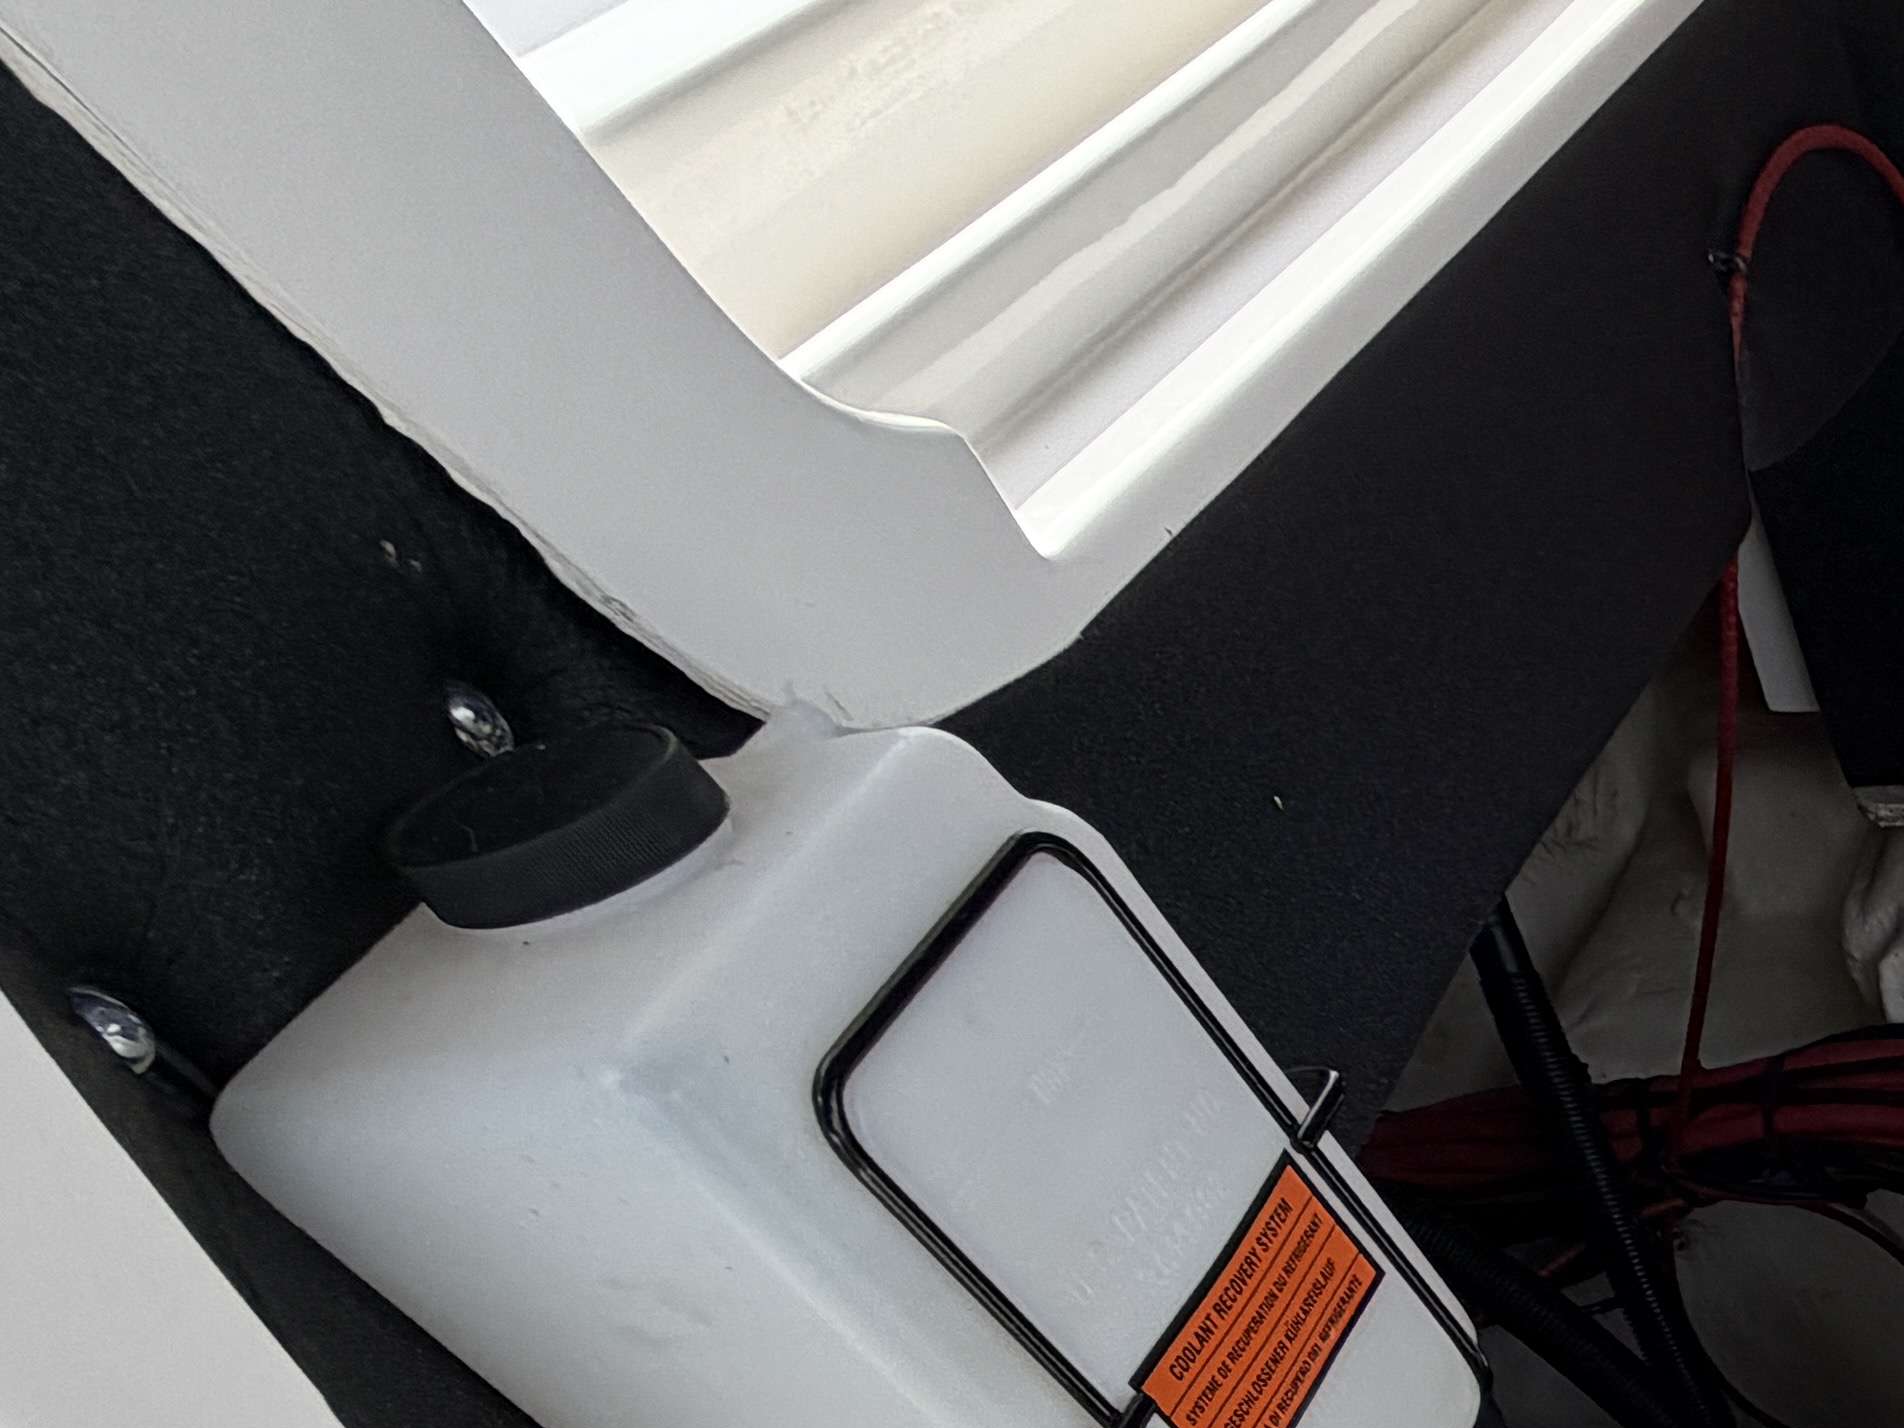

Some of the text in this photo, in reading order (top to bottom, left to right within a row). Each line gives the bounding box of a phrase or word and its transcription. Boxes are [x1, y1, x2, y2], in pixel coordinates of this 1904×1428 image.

[1169, 1197, 1292, 1380] COOLANT RECOVERY SYSTEM
[1216, 1360, 1232, 1379] DE
